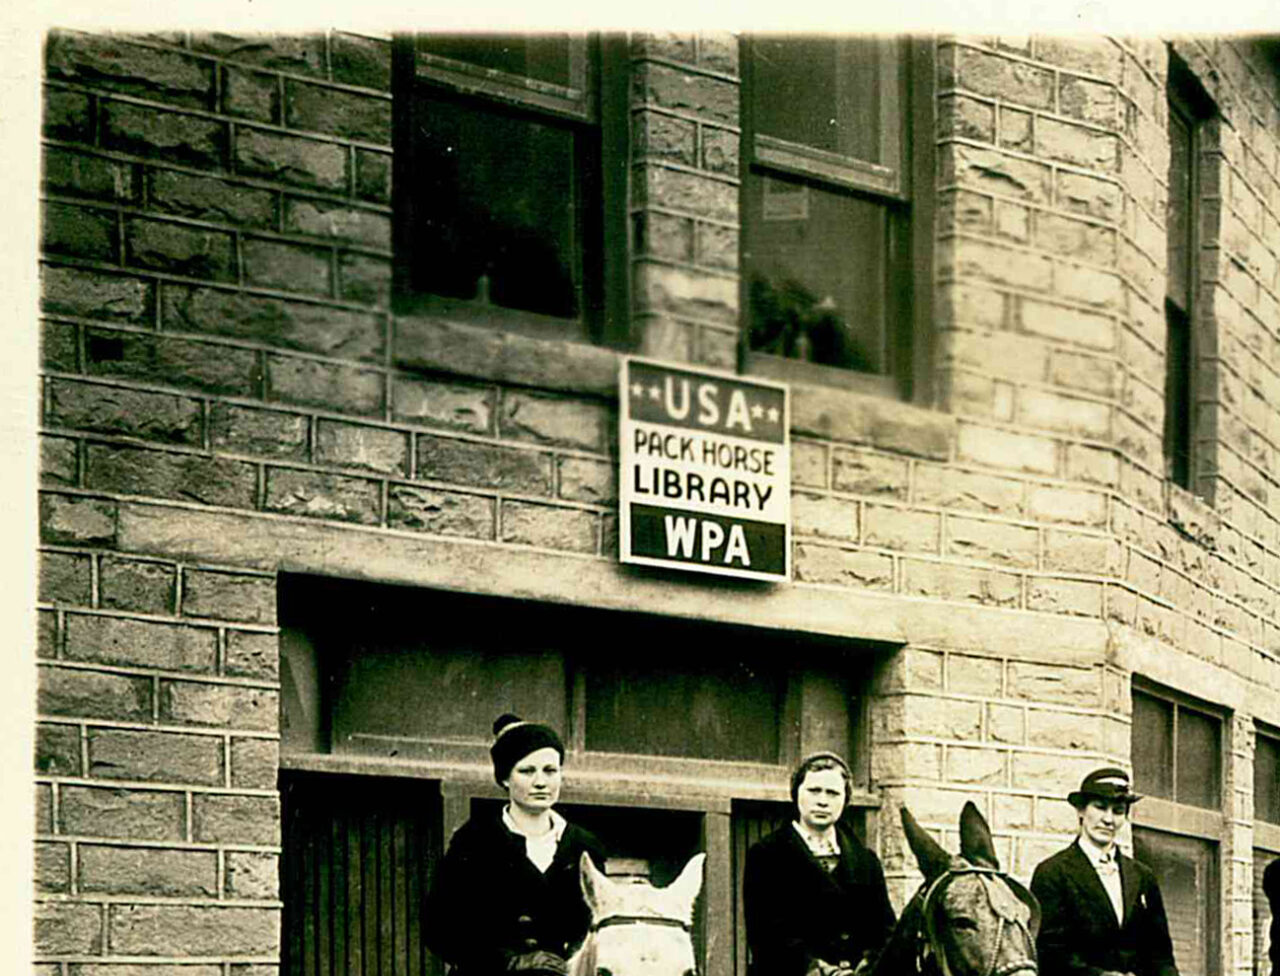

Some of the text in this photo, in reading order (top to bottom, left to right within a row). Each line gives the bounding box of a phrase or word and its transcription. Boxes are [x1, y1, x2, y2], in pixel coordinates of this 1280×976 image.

[665, 377, 752, 431] USA
[634, 428, 775, 476] PACK HORSE
[634, 464, 773, 511] LIBRARY
[664, 514, 751, 566] WPA
